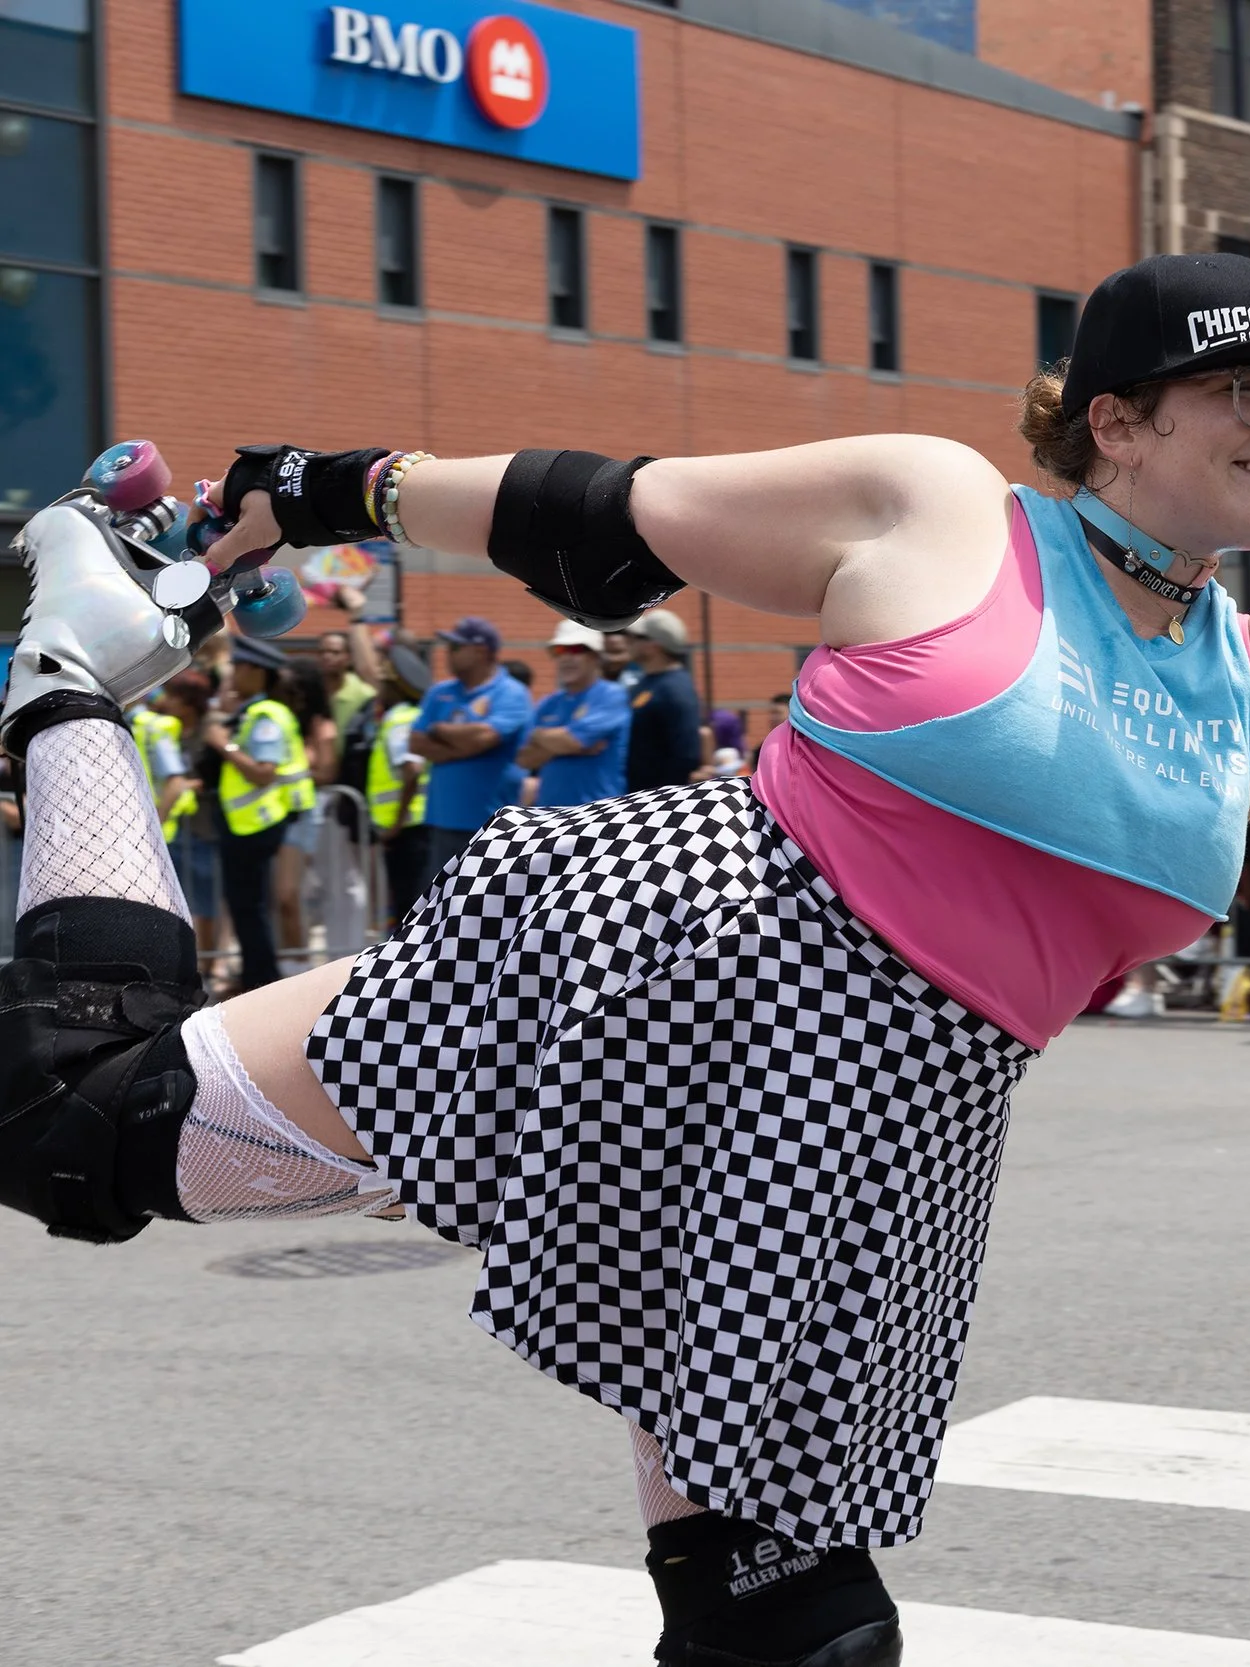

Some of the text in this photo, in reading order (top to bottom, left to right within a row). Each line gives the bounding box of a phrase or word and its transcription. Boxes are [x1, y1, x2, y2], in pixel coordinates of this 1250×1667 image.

[330, 5, 463, 84] BMO
[278, 451, 302, 493] 187
[291, 465, 306, 497] KILLER
[1138, 570, 1180, 600] CHOKER
[1112, 682, 1242, 743] EQUITY
[1051, 694, 1099, 731] UNTIL
[1155, 762, 1190, 784] ALL
[1112, 712, 1249, 775] ILLINIS
[729, 1551, 819, 1596] KILLER PADS
[731, 1538, 785, 1576] 18
